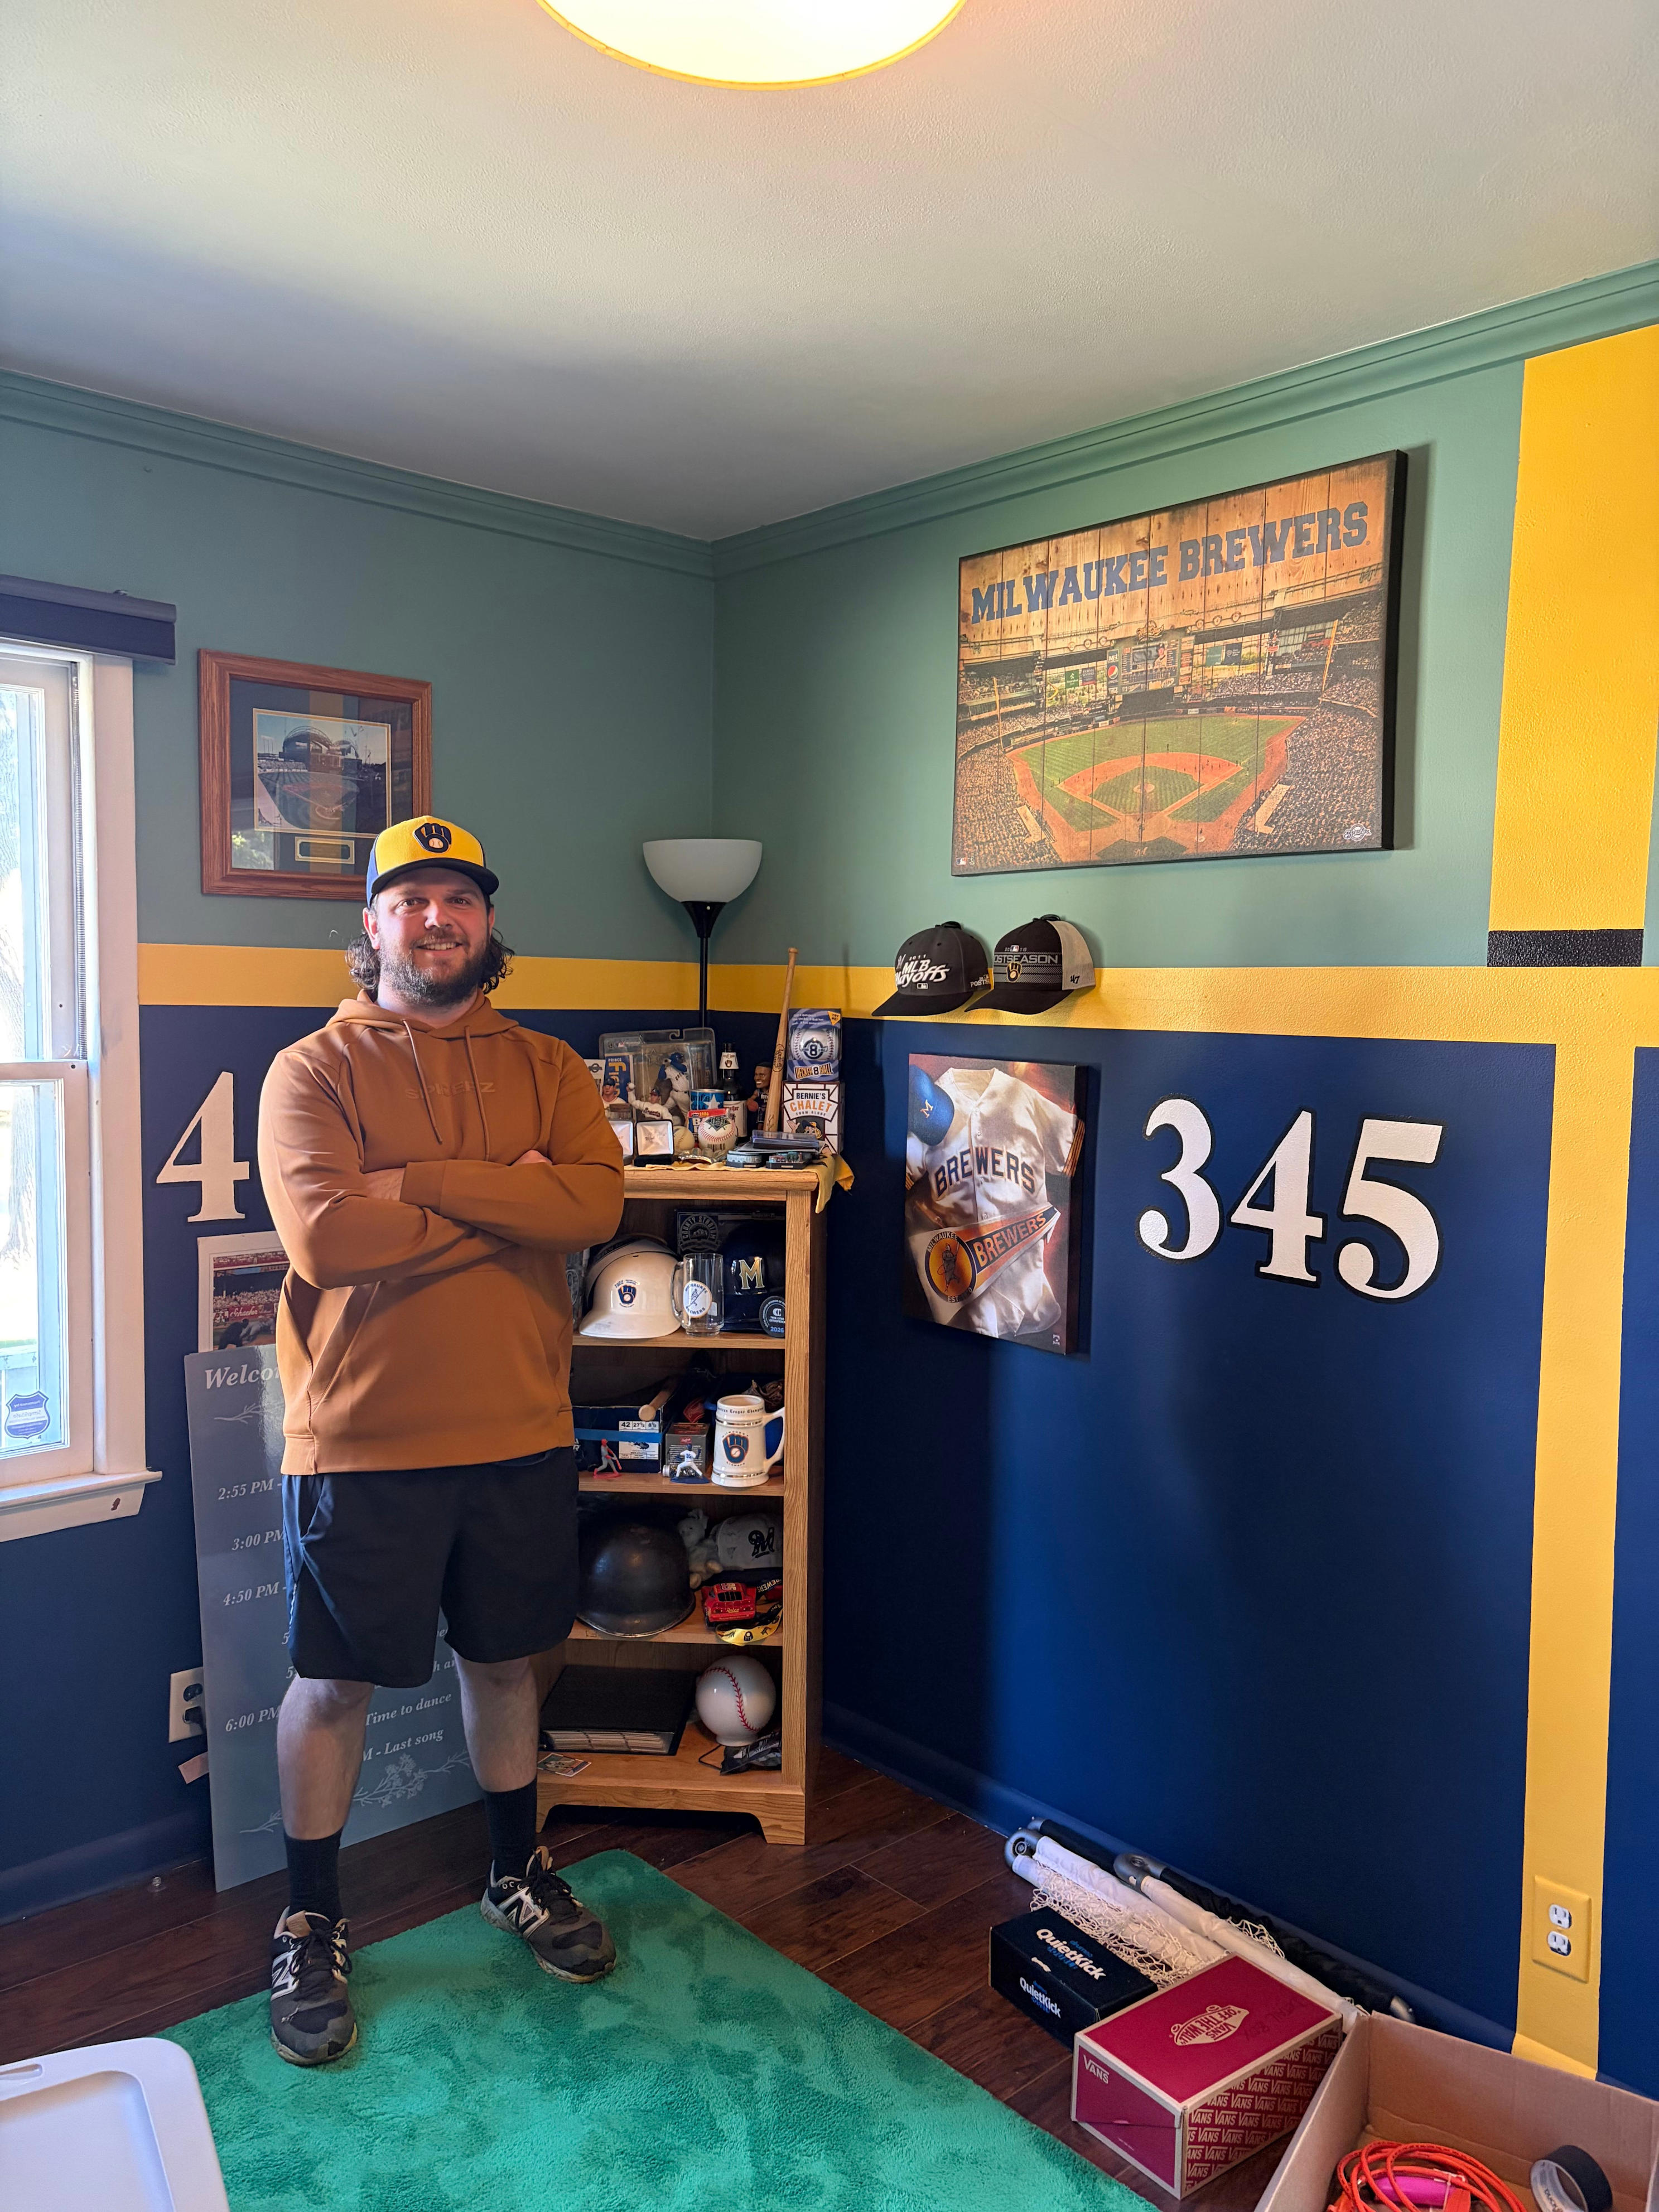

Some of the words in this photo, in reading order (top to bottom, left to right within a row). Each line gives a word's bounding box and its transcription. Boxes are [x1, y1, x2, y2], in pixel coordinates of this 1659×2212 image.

[971, 545, 1168, 624] MILWAUKEE
[1179, 501, 1368, 582] BREWERS
[901, 959, 931, 975] MLB
[810, 1044, 817, 1056] 8
[795, 1066, 813, 1079] UECKER
[814, 1066, 819, 1075] 8
[819, 1063, 833, 1075] BALL
[789, 1100, 832, 1113] CHALET
[920, 1099, 933, 1118] M
[935, 1145, 1036, 1197] BREWERS
[1138, 1098, 1444, 1300] 345
[682, 1218, 696, 1239] COUNTY
[698, 1215, 717, 1239] STADIUM
[927, 1231, 959, 1253] MILWAUKEE
[973, 1215, 1046, 1267] BREWERS
[739, 1258, 765, 1289] M
[685, 1283, 708, 1294] MILWAUKEE
[218, 1484, 247, 1500] 2:55
[250, 1479, 274, 1495] PM
[232, 1533, 261, 1551] 3:00
[223, 1588, 252, 1606] 4:50
[255, 1582, 279, 1599] PM
[365, 1710, 397, 1726] Time
[401, 1705, 413, 1716] to
[416, 1693, 452, 1711] dance
[225, 1713, 255, 1732] 6:00
[384, 1736, 412, 1755] Last
[414, 1729, 444, 1746] song
[1036, 1929, 1107, 1980] QuietKick
[1019, 1977, 1062, 2018] QuietKick
[1195, 2015, 1222, 2030] THE
[1205, 2022, 1237, 2040] VANS
[1283, 2048, 1302, 2061] ANS
[1303, 2049, 1325, 2064] VANS
[1083, 2054, 1110, 2084] VANS
[1263, 2063, 1286, 2077] VANS
[1286, 2064, 1309, 2080] VANS
[1248, 2078, 1270, 2093] VANS
[1271, 2079, 1293, 2095] VANS
[1231, 2093, 1255, 2109] VANS
[1255, 2095, 1278, 2112] VANS
[1277, 2098, 1300, 2113] VANS
[1190, 2108, 1214, 2124] VANS
[1214, 2110, 1238, 2126] VANS
[1238, 2111, 1262, 2128] VANS
[1261, 2113, 1284, 2129] VANS
[1198, 2127, 1222, 2143] VANS
[1222, 2128, 1245, 2145] VANS
[1187, 2145, 1205, 2160] ANS
[1204, 2145, 1229, 2161] VANS
[1187, 2162, 1212, 2178] VANS
